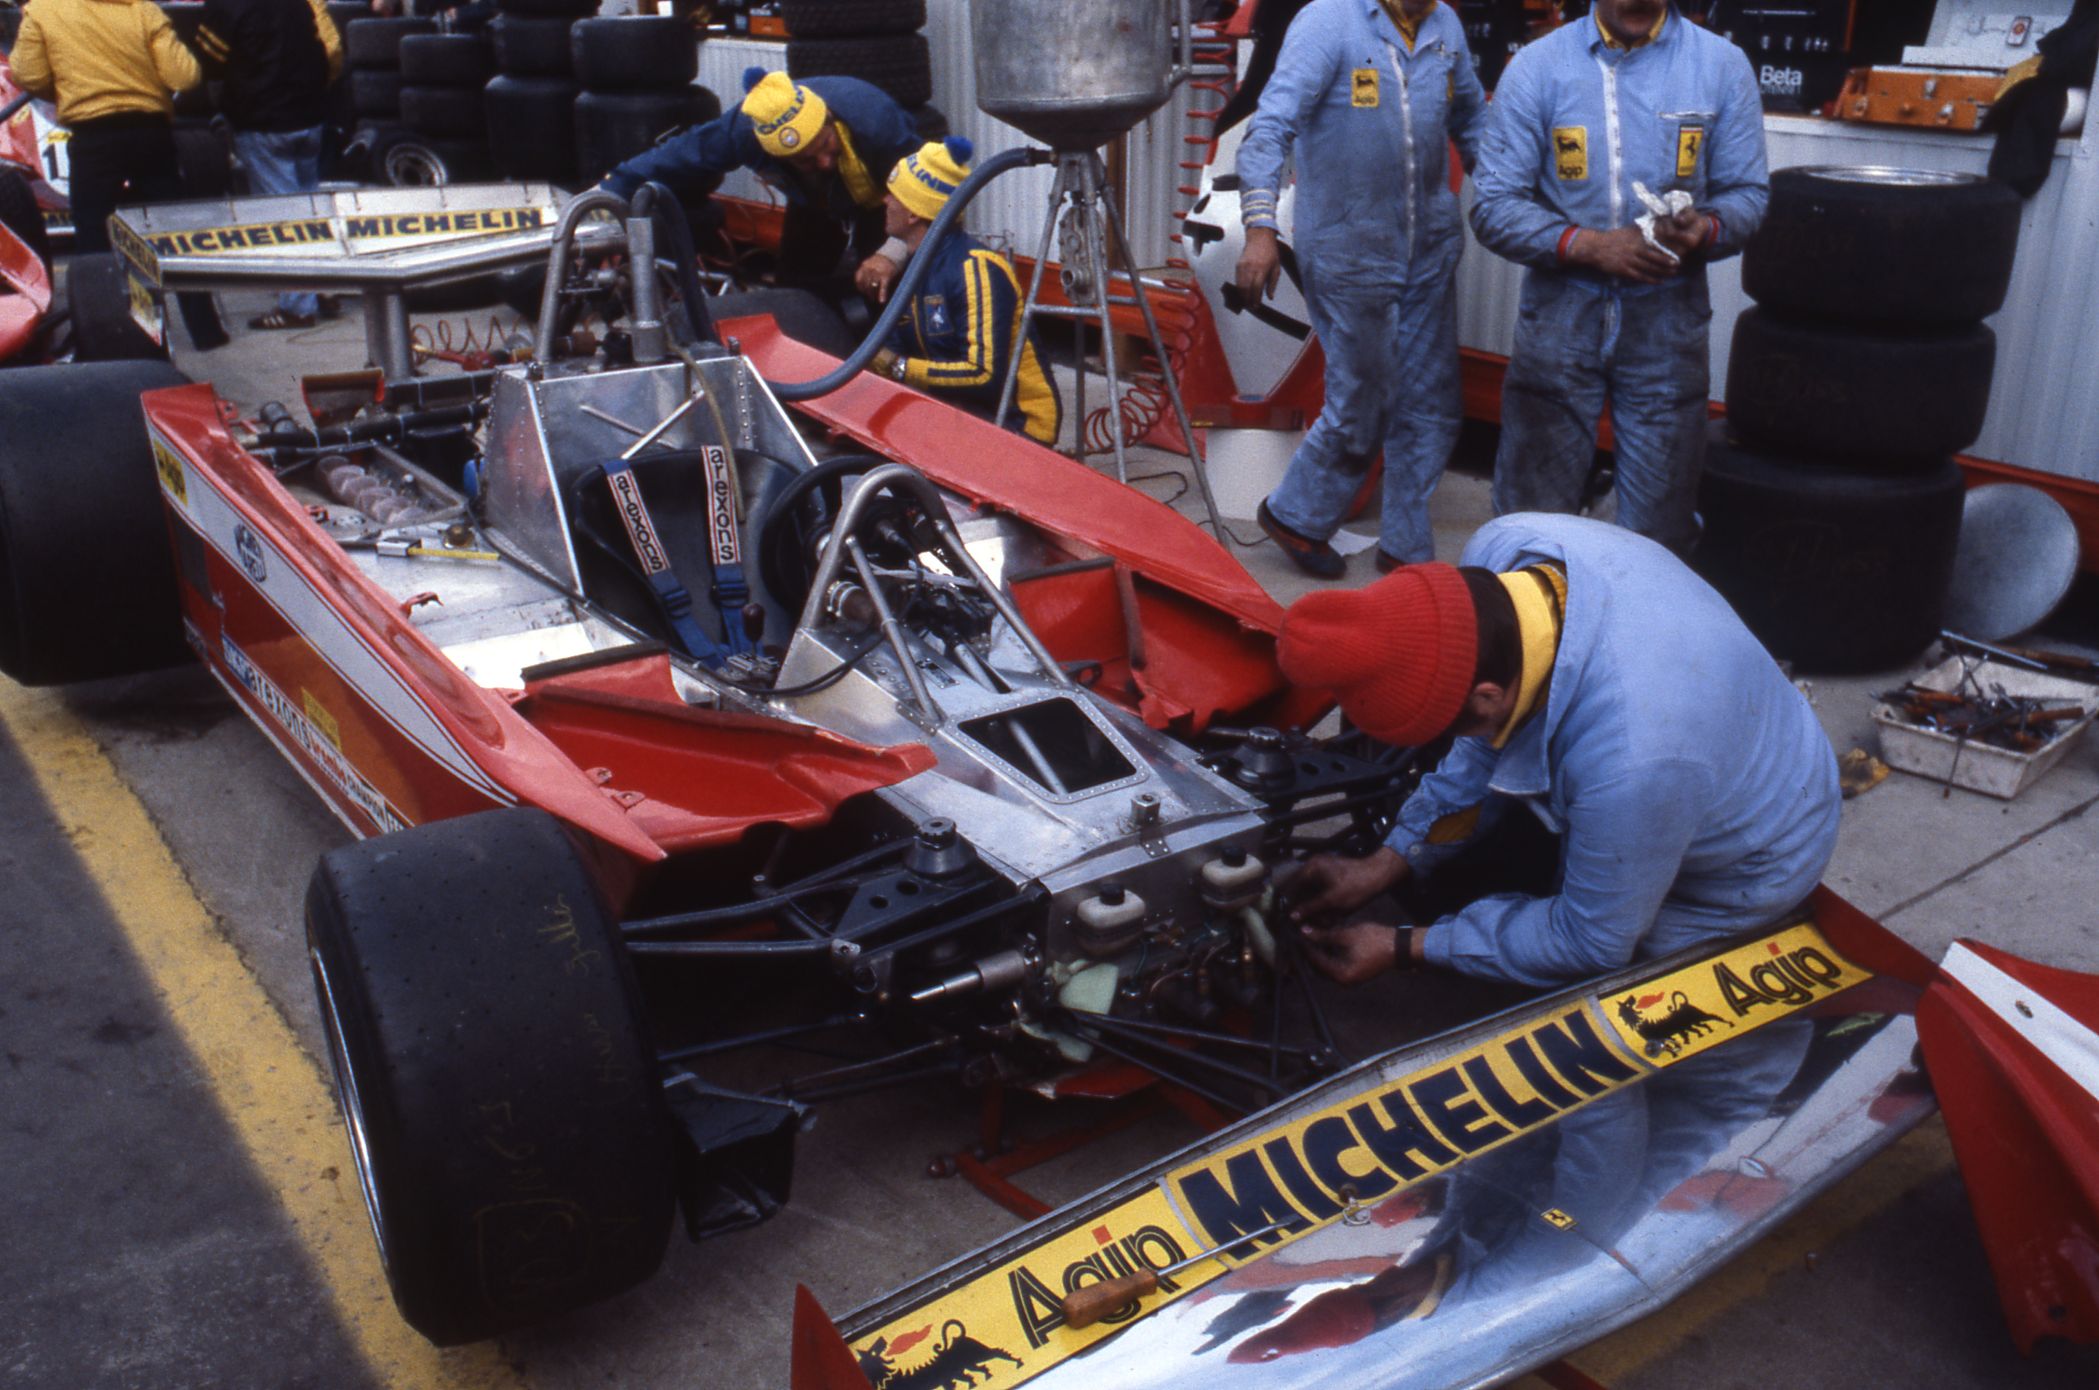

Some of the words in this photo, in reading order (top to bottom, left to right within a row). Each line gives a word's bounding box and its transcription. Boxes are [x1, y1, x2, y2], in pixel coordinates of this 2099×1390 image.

[1760, 65, 1803, 86] Beta
[147, 220, 334, 255] MICHELIN
[348, 208, 541, 239] MICHELIN
[616, 475, 663, 571] arexons
[710, 449, 735, 561] arexons
[1178, 1009, 1641, 1261] MICHELIN
[1712, 941, 1842, 1018] Agip
